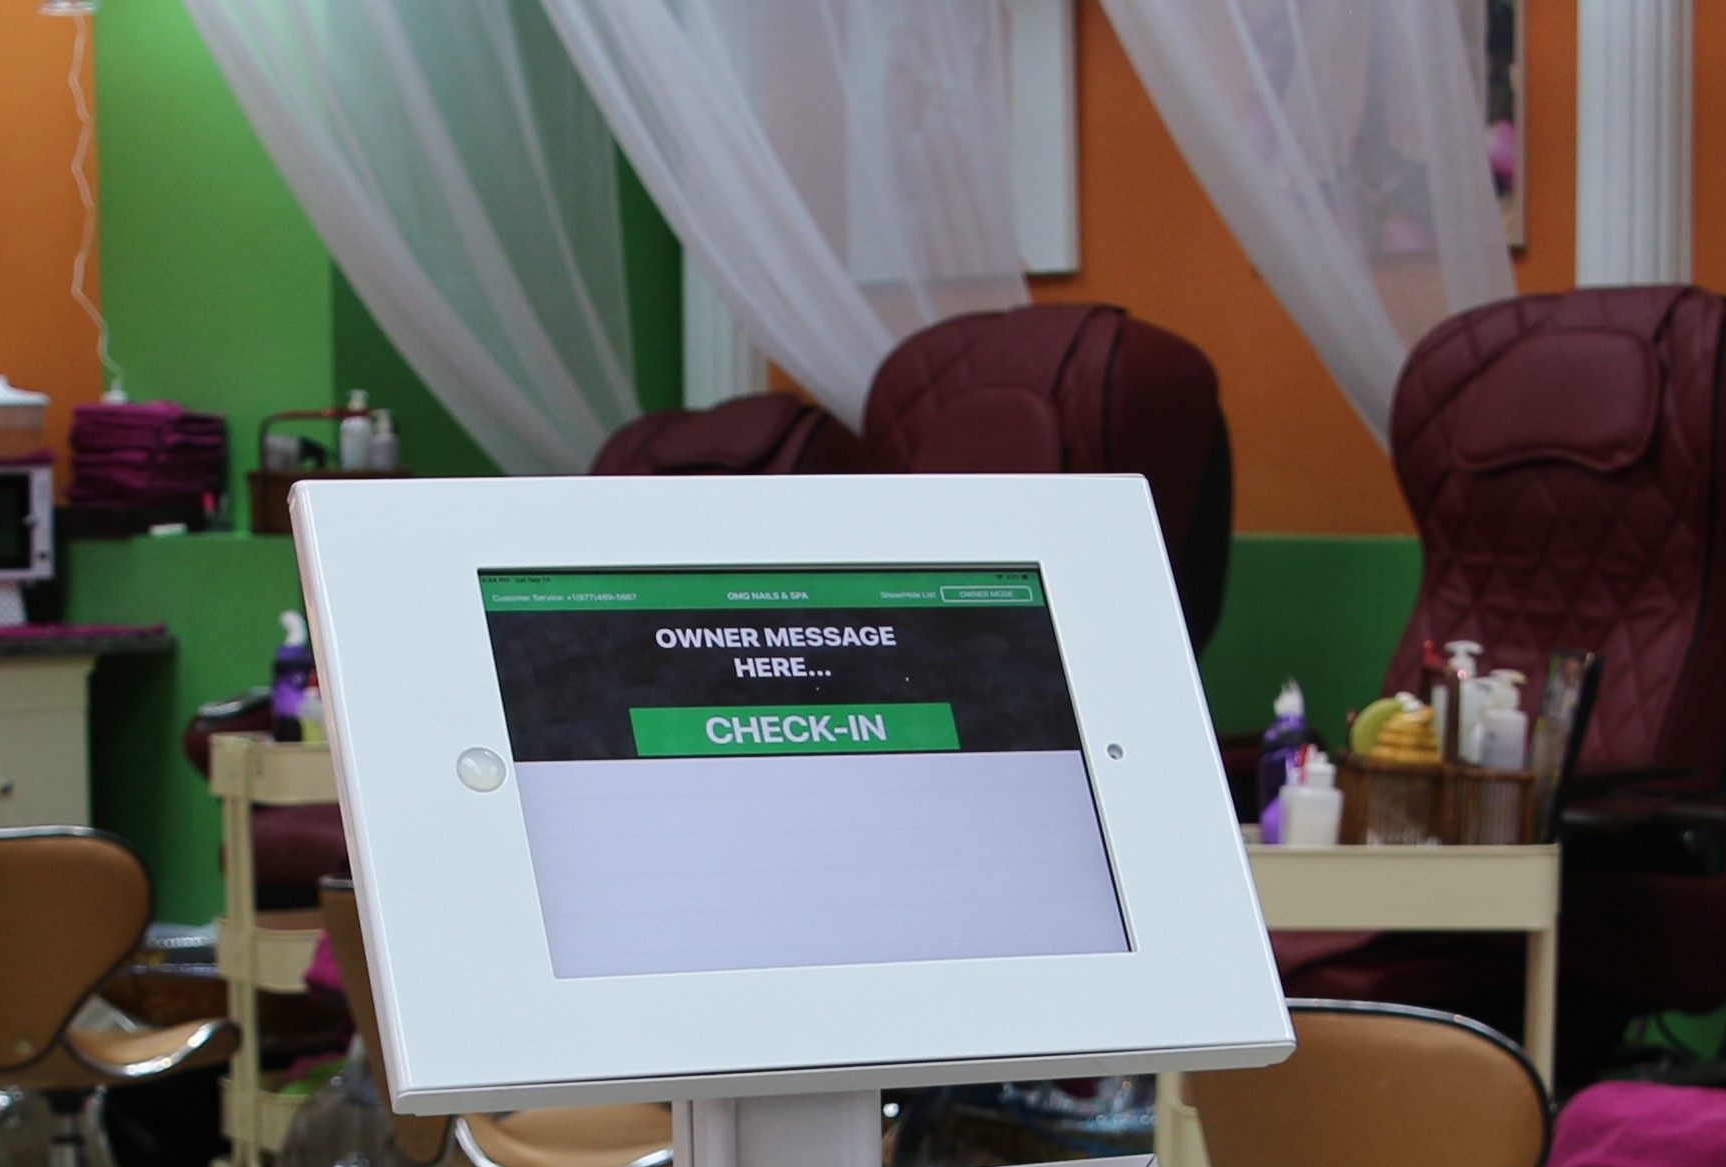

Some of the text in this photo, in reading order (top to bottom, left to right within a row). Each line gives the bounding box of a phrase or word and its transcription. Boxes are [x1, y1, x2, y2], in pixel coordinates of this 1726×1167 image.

[728, 591, 750, 600] OMG
[751, 591, 780, 600] NAILS
[790, 591, 809, 600] SPA
[655, 626, 897, 649] OWNER MESSAGE
[734, 657, 832, 678] HERE...
[705, 713, 888, 745] CHECK-IN
